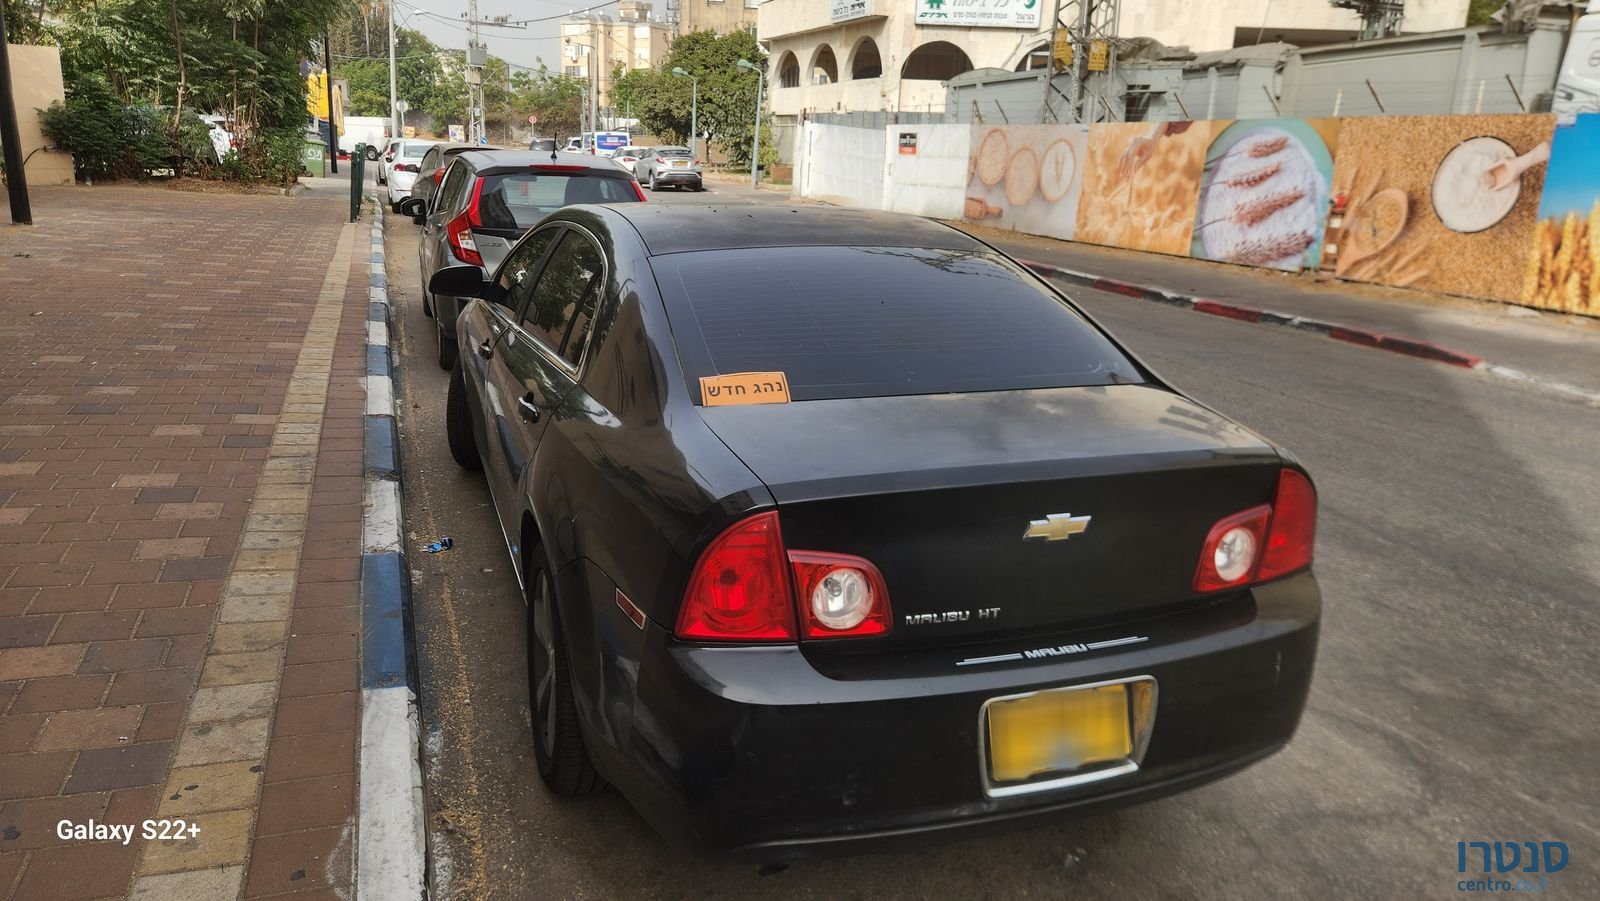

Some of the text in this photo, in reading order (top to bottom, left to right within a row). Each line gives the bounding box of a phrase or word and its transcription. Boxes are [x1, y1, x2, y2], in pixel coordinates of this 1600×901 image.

[707, 381, 783, 397] נהג חדש
[905, 607, 1001, 626] MALIBU HT
[1024, 643, 1088, 659] MALIBU
